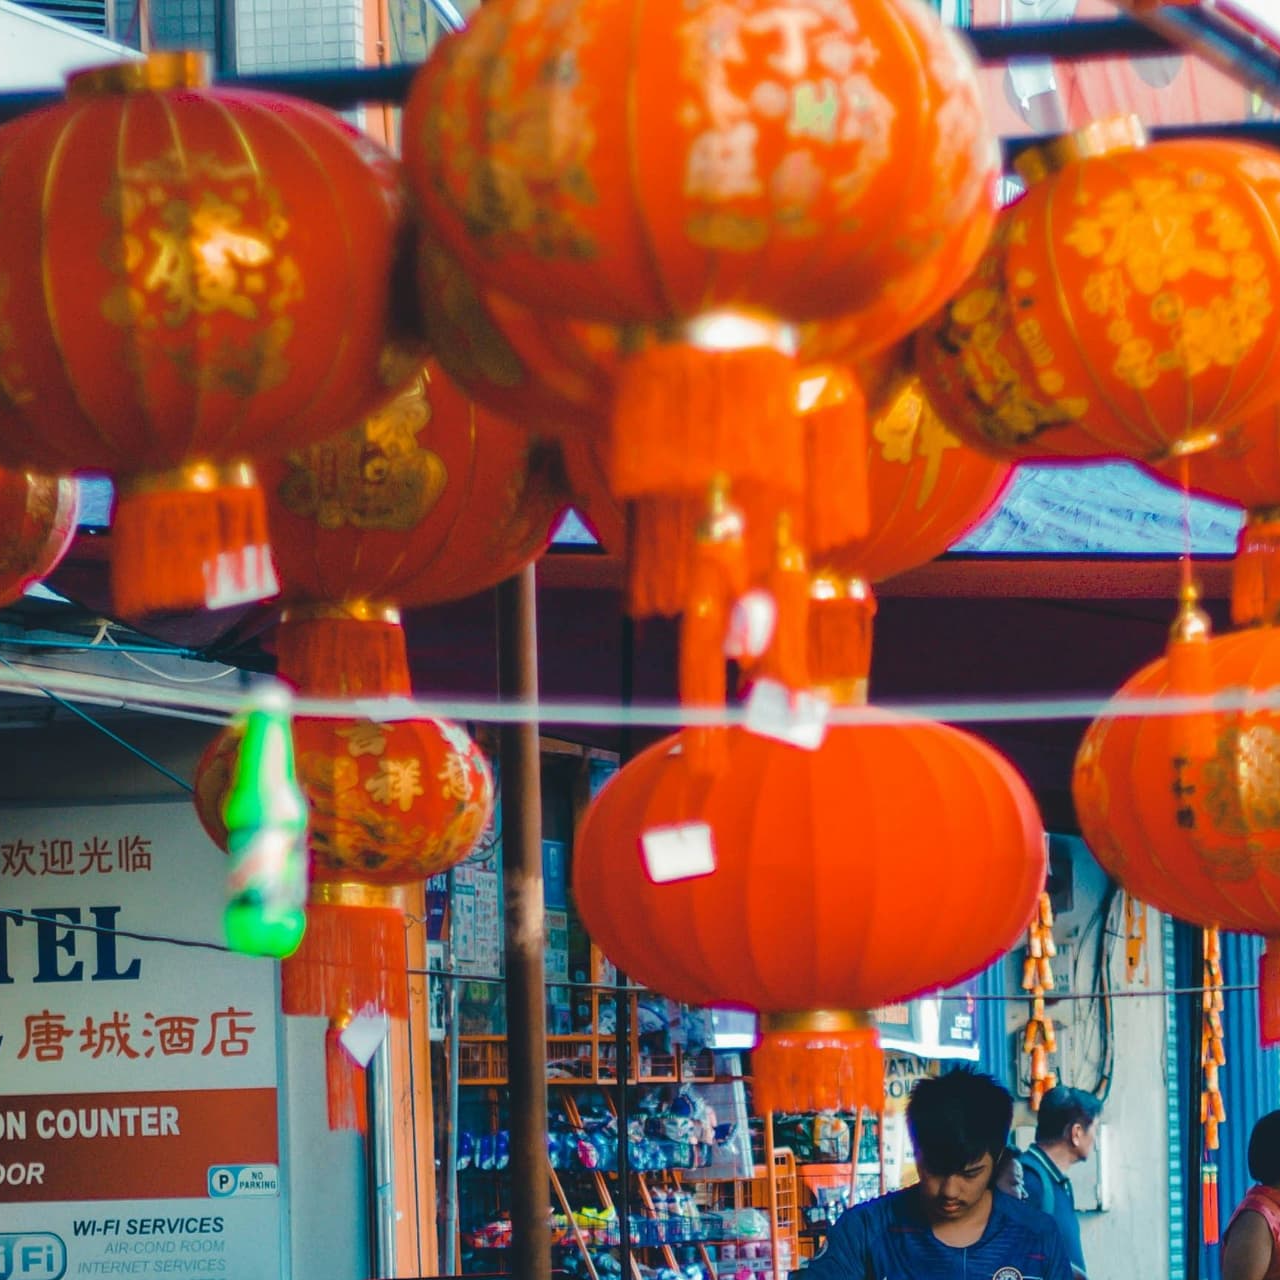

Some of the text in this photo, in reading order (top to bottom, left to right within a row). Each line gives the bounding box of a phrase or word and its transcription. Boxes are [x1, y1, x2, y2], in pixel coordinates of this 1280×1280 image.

[1, 835, 152, 876] 欢迎光临
[17, 1006, 256, 1062] 唐城酒店
[36, 1106, 180, 1139] COUNTER
[251, 1171, 264, 1180] NO
[239, 1180, 276, 1190] PARKING
[73, 1216, 224, 1237] WI-FI SERVICES
[104, 1239, 225, 1254] AIR-COND ROOM
[78, 1258, 226, 1274] INTERNET SERVICES
